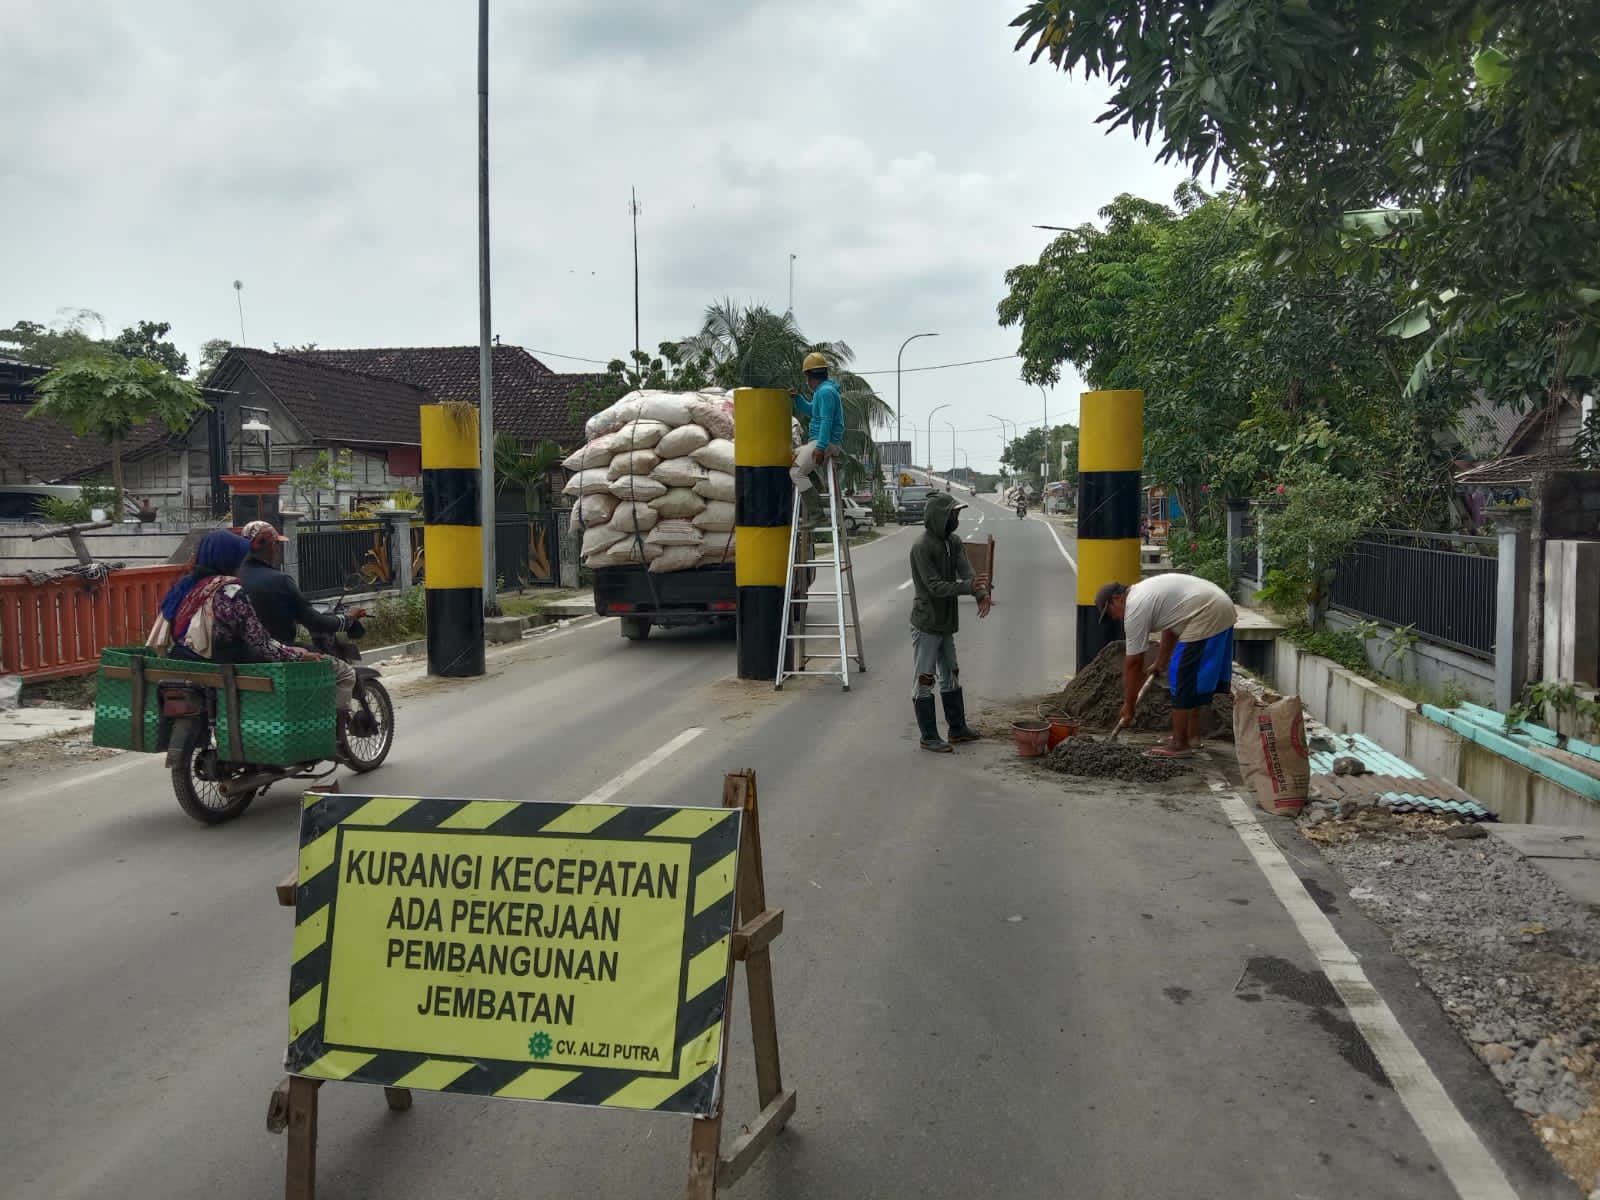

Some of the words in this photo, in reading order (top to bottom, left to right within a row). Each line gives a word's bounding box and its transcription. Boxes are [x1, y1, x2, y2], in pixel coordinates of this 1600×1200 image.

[345, 849, 482, 890] KURANGI
[490, 855, 679, 900] KECEPATAN
[386, 896, 444, 933] ADA
[450, 899, 621, 942] PEKERJAAN
[386, 938, 619, 982] PEMBANGUNAN
[417, 984, 575, 1026] JEMBATAN
[556, 1039, 577, 1055] CV.
[580, 1041, 611, 1059] ALZI
[613, 1043, 660, 1062] PUTRA
